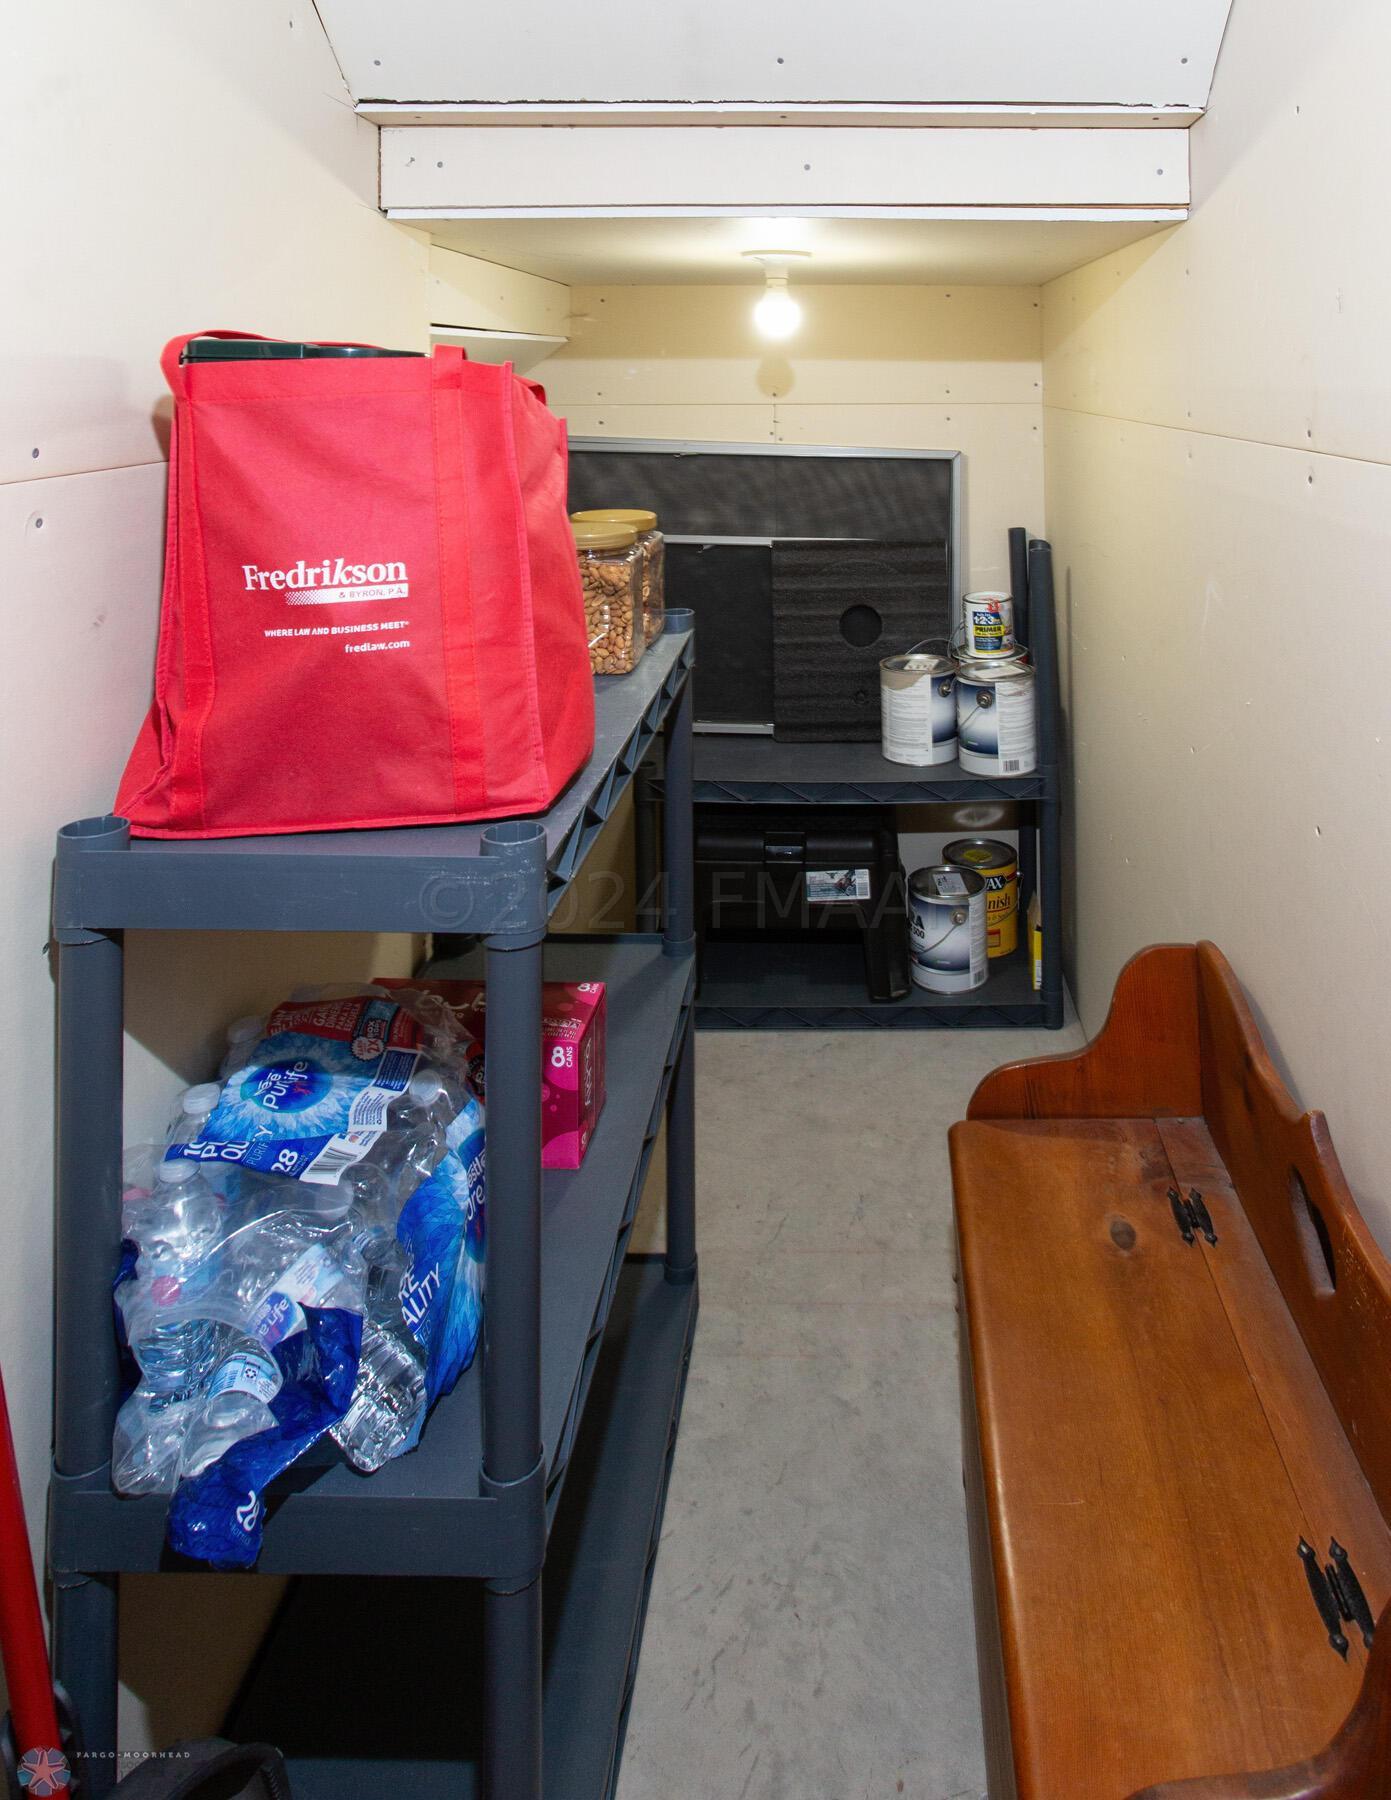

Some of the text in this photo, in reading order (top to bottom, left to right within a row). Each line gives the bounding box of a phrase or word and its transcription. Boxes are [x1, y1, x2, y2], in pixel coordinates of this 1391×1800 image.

[241, 557, 408, 591] Fredrikson
[264, 628, 293, 638] WHERE
[294, 627, 311, 637] LAW
[311, 626, 330, 636] AND
[331, 623, 379, 635] BUSINESS
[344, 639, 410, 654] fredlaw.com
[988, 893, 1011, 910] nish
[551, 1045, 566, 1068] 8
[271, 1148, 299, 1172] 28
[402, 1262, 442, 1326] ALITY
